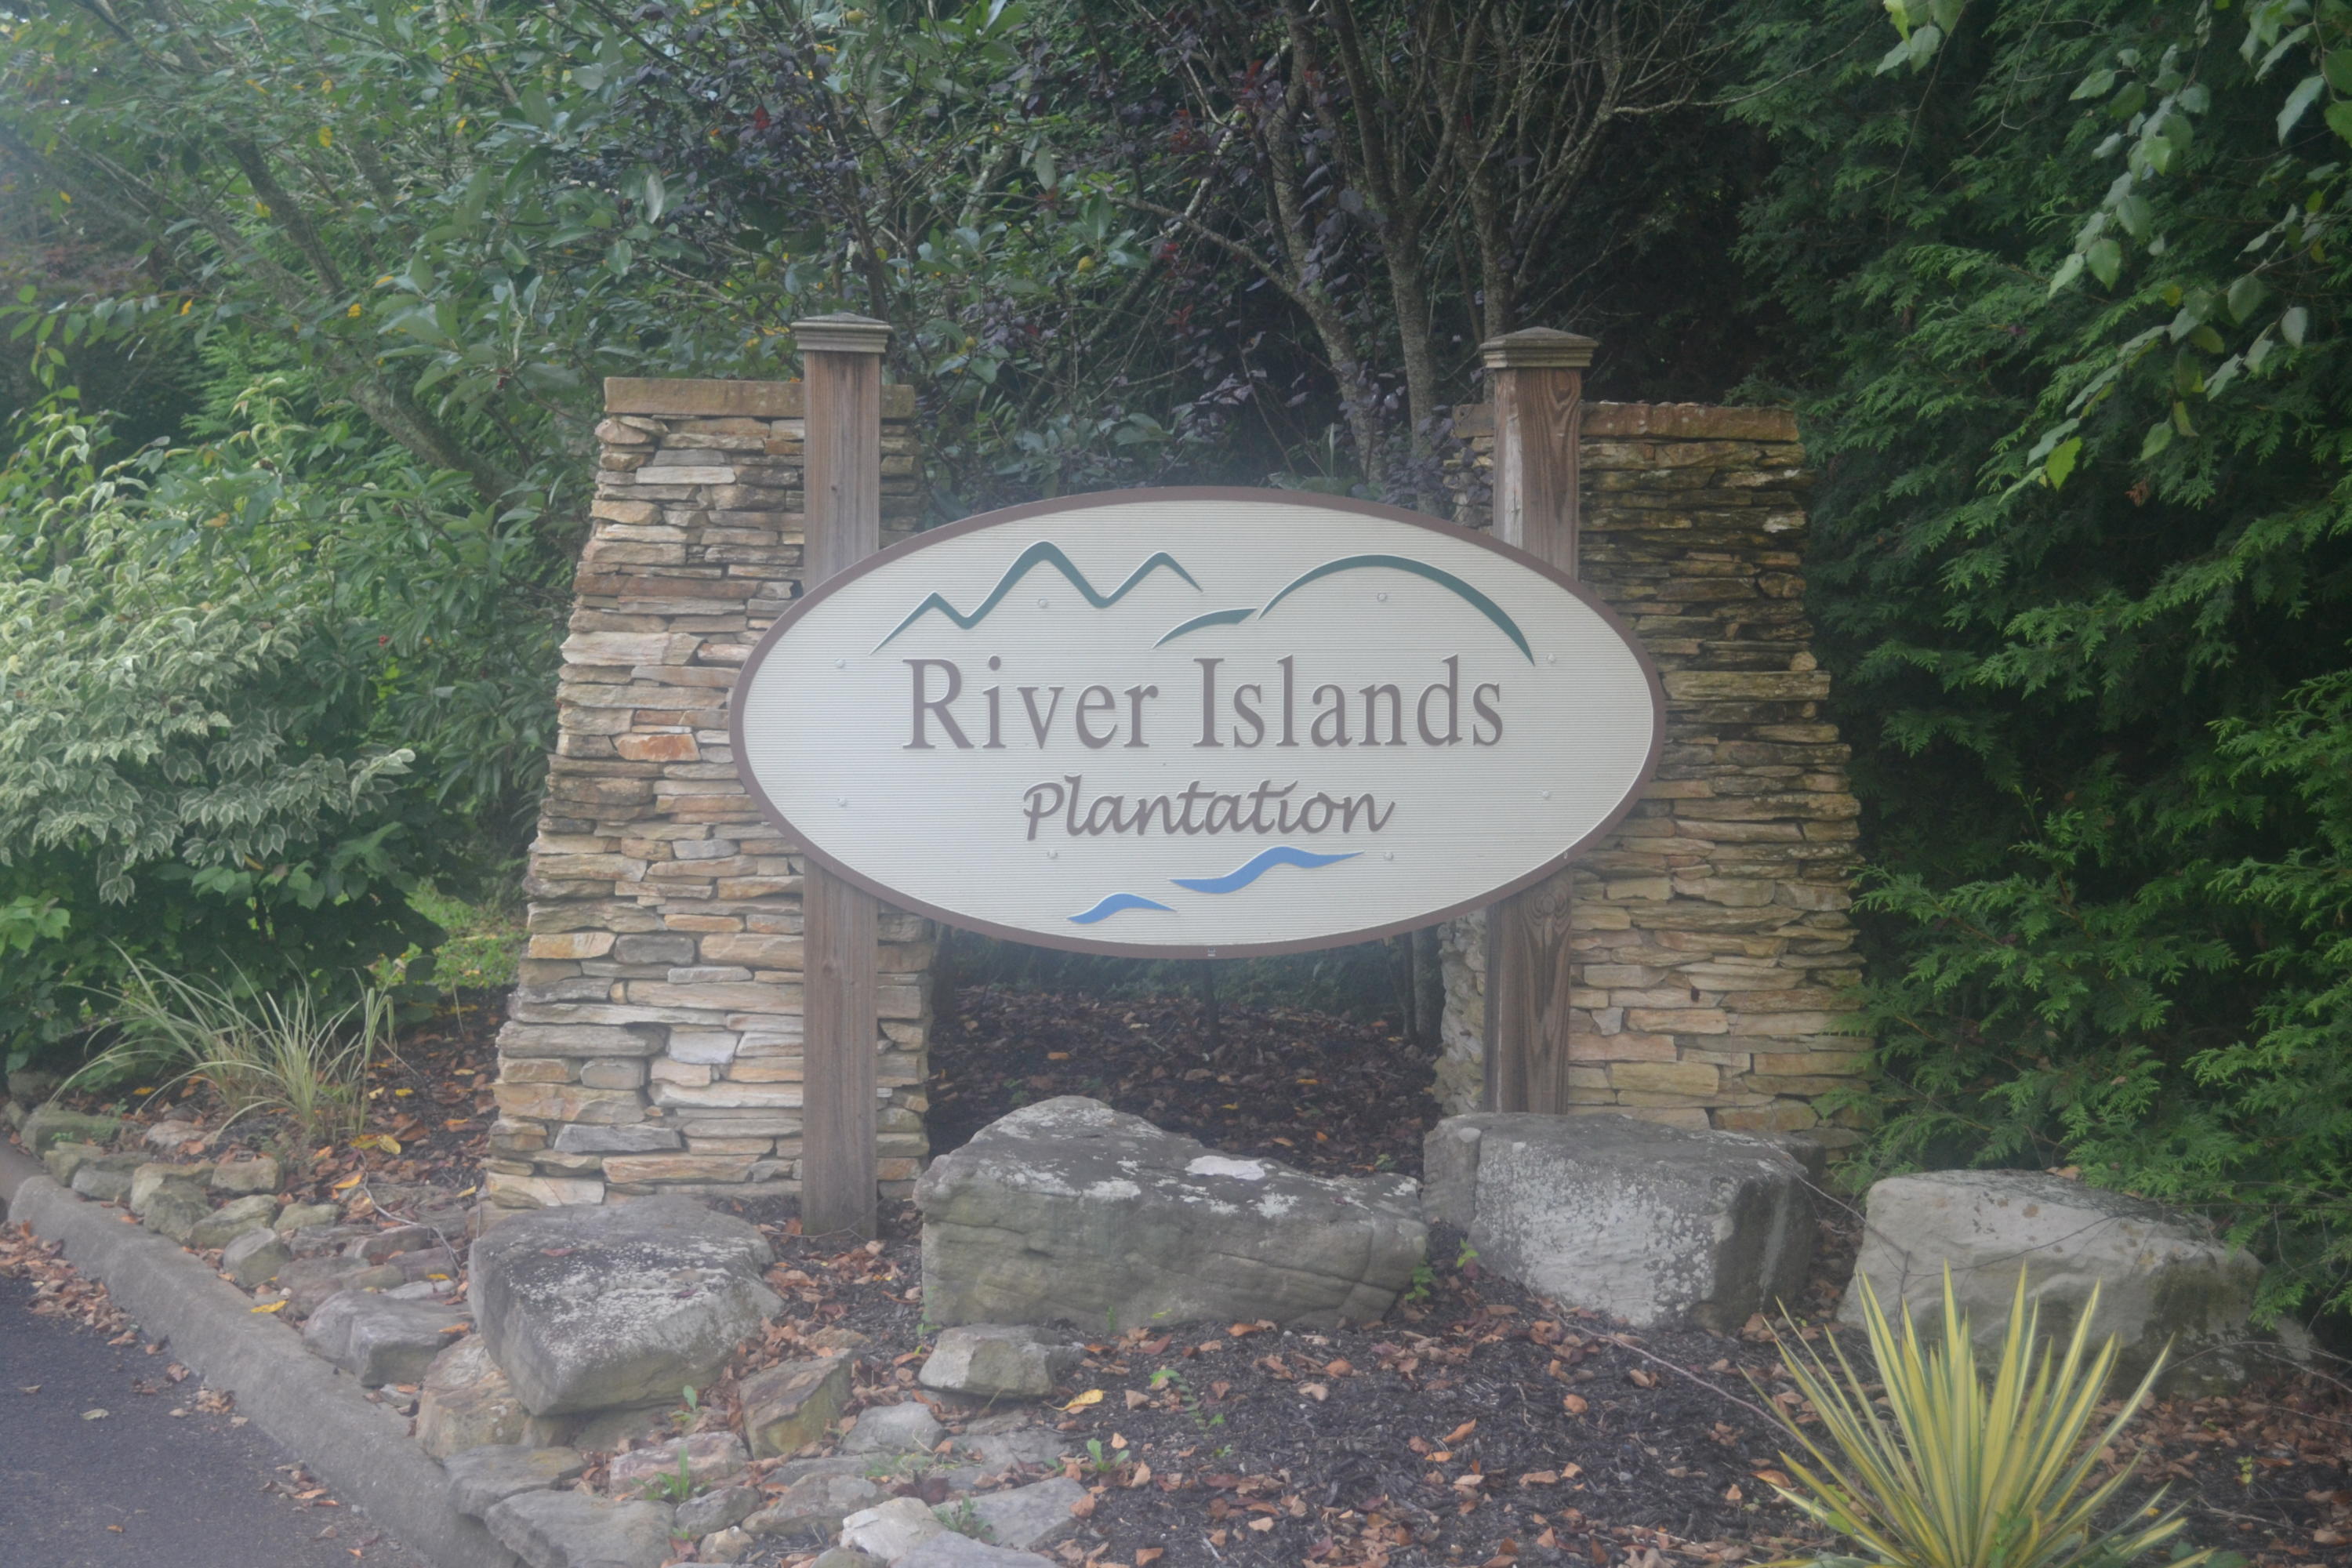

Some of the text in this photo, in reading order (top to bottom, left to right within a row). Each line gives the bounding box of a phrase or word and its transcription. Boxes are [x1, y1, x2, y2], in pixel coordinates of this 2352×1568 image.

[902, 654, 1504, 750] River Islands
[1022, 775, 1396, 841] Plantation
